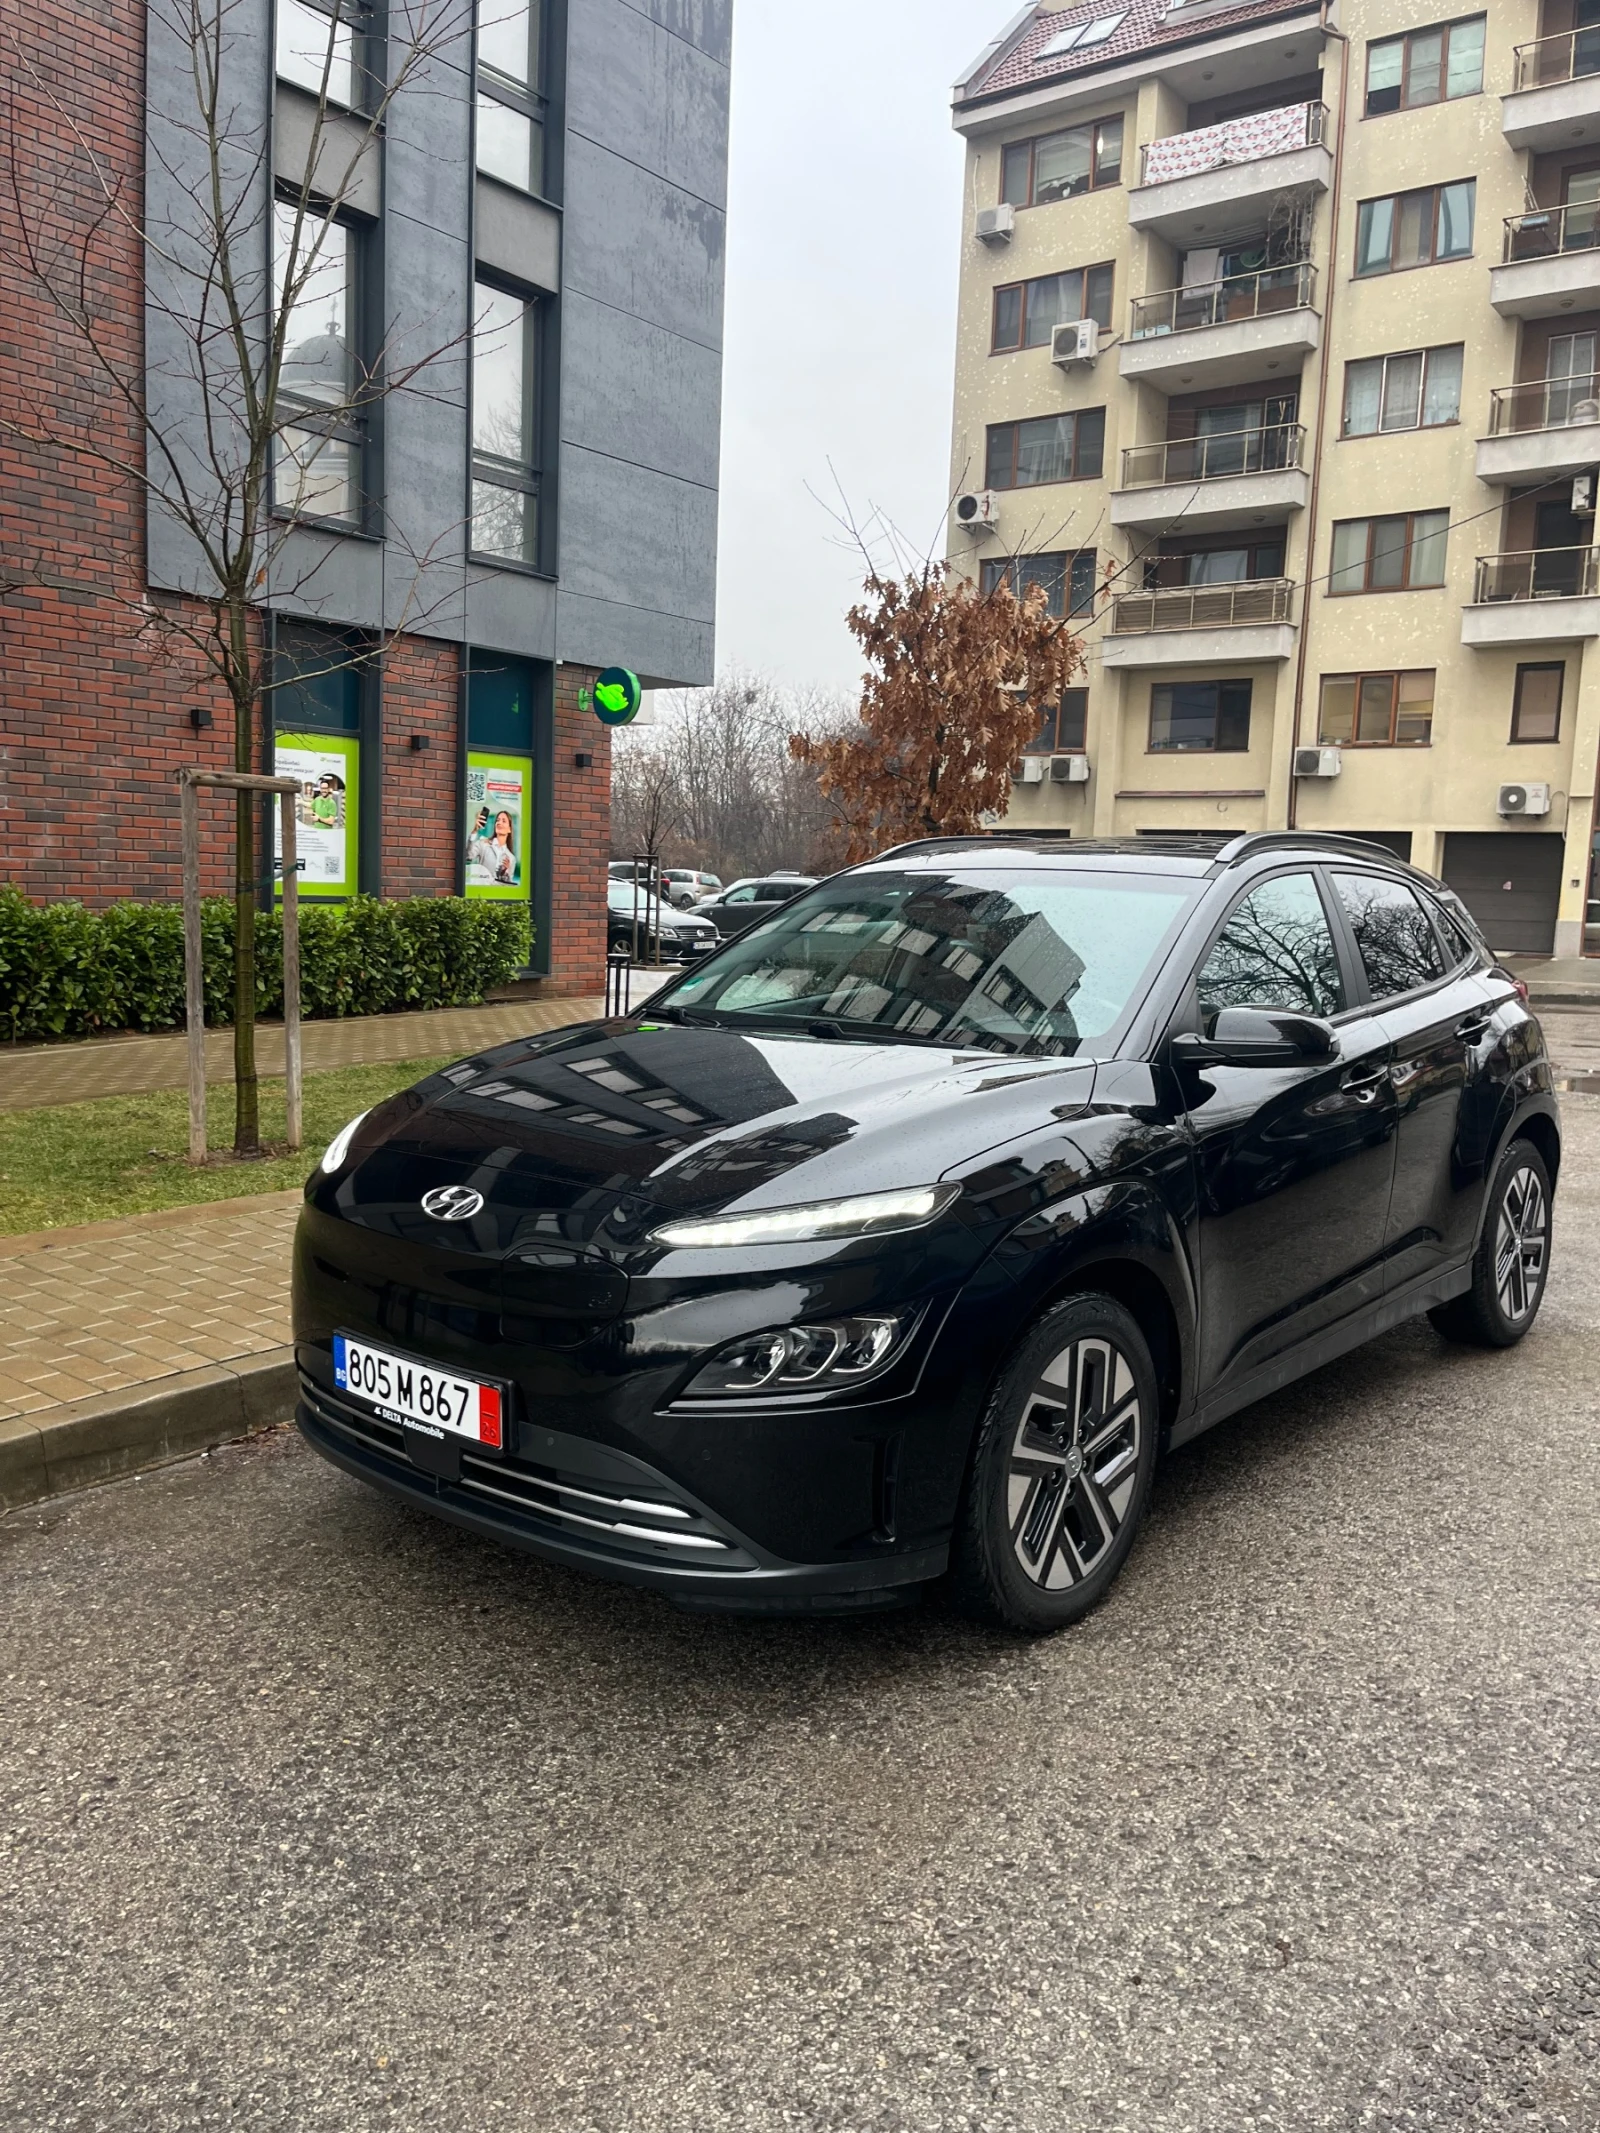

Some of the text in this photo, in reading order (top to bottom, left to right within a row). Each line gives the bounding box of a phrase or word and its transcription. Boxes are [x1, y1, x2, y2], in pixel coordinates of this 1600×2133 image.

[335, 1367, 346, 1382] BG
[382, 1408, 445, 1440] DELTA Automobile
[482, 1421, 497, 1439] 26
